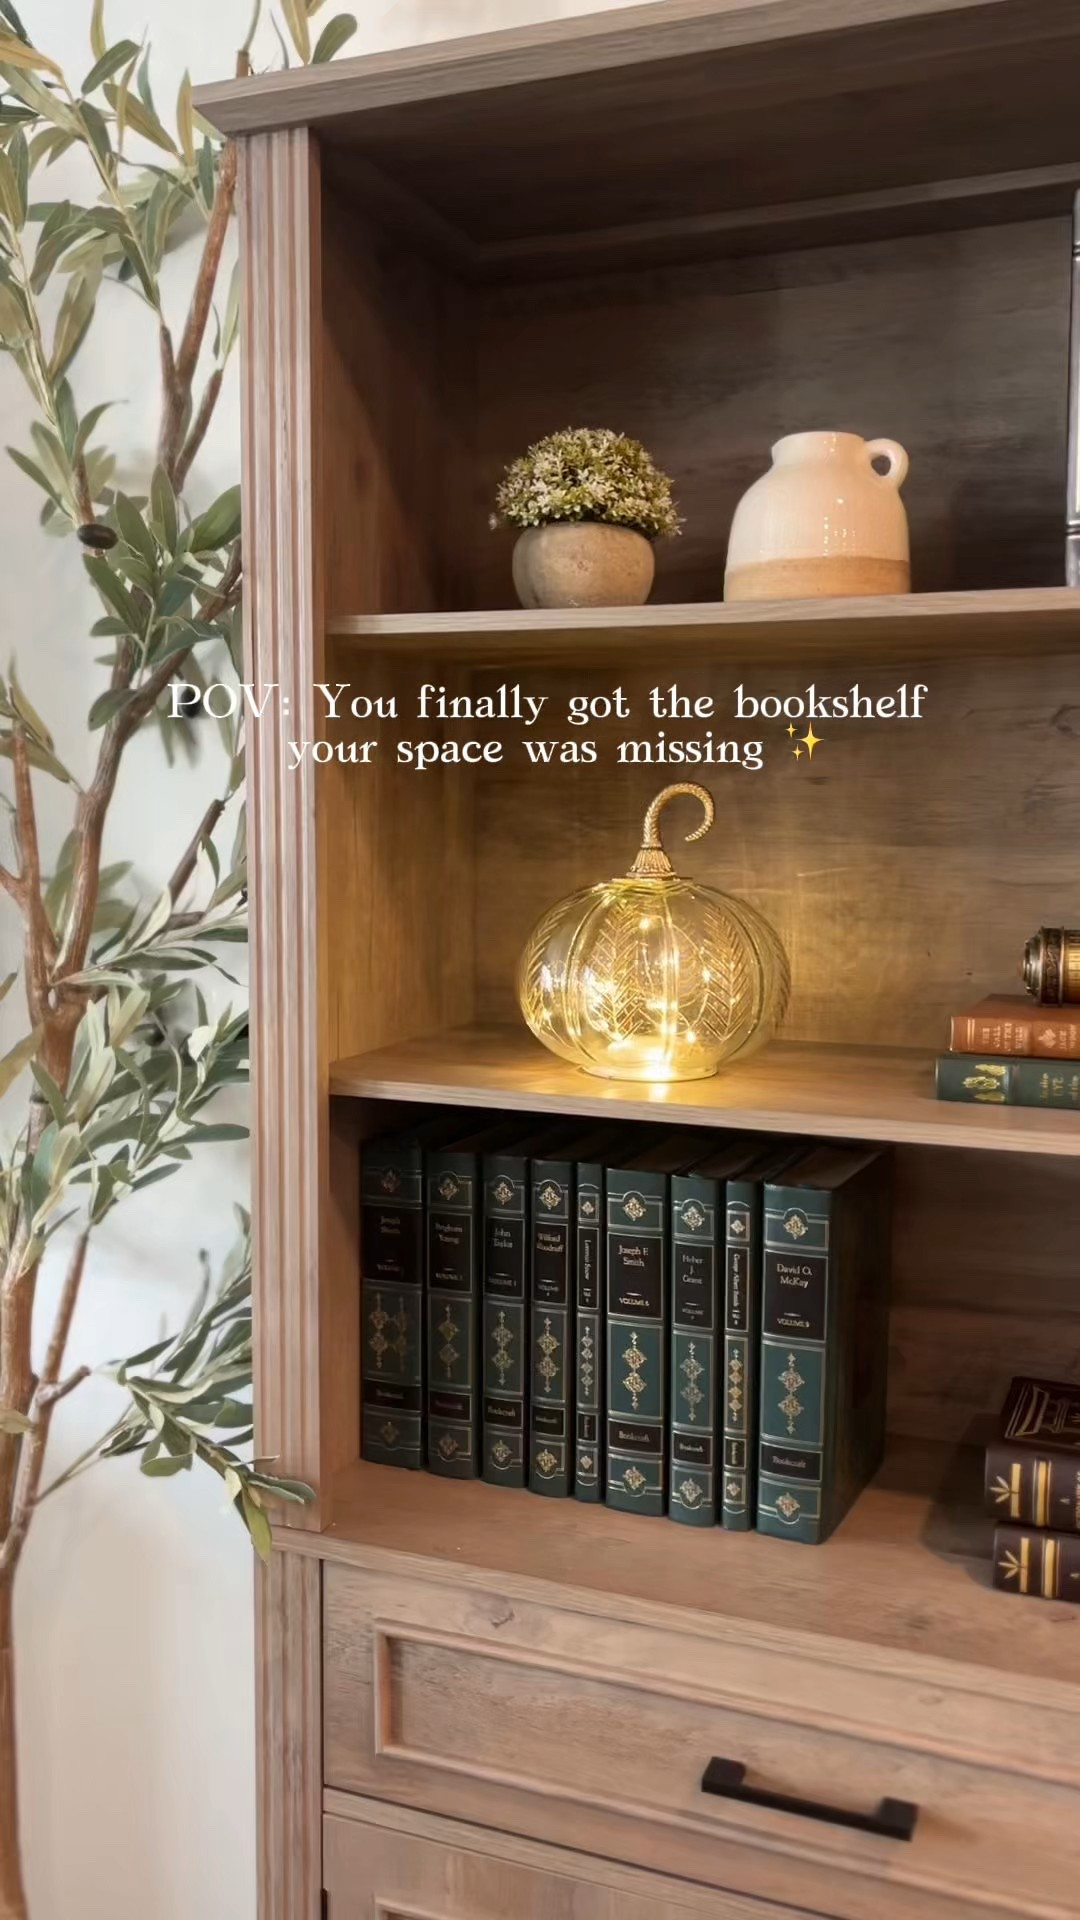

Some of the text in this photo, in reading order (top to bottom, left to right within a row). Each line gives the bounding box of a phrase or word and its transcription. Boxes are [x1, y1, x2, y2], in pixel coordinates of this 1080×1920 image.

[618, 1244, 641, 1256] Joseph
[623, 1256, 645, 1267] Smith
[776, 1263, 800, 1275] David
[780, 1275, 809, 1289] McKay
